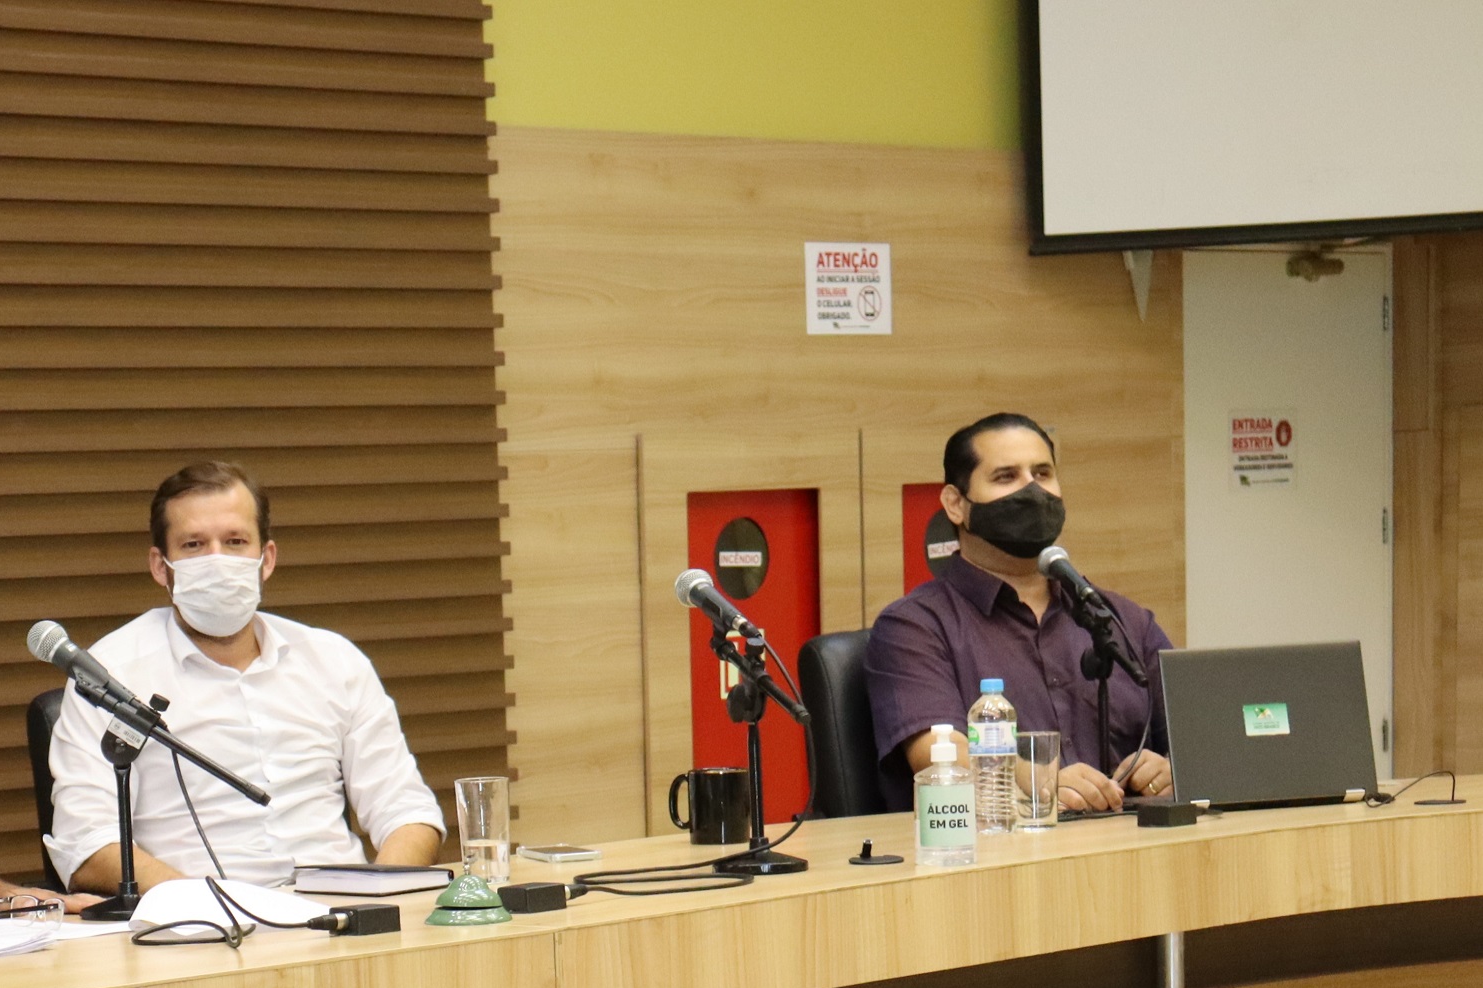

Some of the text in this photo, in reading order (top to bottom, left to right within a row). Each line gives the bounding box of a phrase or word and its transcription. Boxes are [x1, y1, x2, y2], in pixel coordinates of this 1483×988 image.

[817, 248, 879, 273] ATENÇÃO
[1232, 418, 1272, 431] ENTRADA
[1232, 437, 1273, 449] RESTRITA
[719, 552, 760, 564] INCÊNDIO
[927, 803, 970, 814] ÁLCOOL
[929, 818, 969, 829] EM GEL
